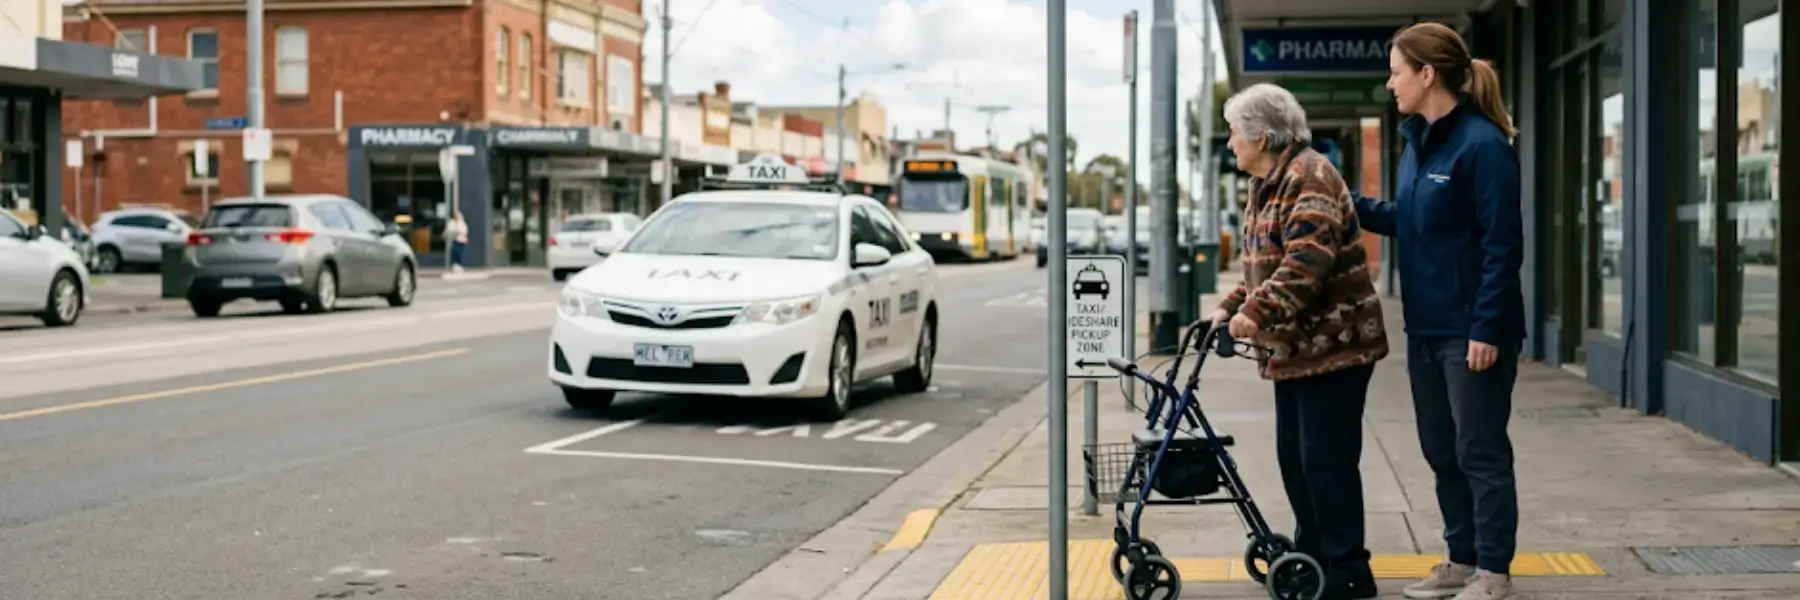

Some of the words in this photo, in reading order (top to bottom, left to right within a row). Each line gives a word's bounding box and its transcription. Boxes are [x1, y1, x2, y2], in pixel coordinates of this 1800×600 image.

[1278, 40, 1392, 59] PHARMAC
[361, 128, 456, 145] PHARMACY
[748, 165, 788, 180] TAXI
[647, 268, 742, 281] TAXI
[868, 296, 891, 329] TAXI
[1076, 303, 1106, 314] TAXI/
[1067, 316, 1120, 327] IDESHARE
[1071, 329, 1110, 340] PICKUP
[1076, 341, 1105, 353] ZONE
